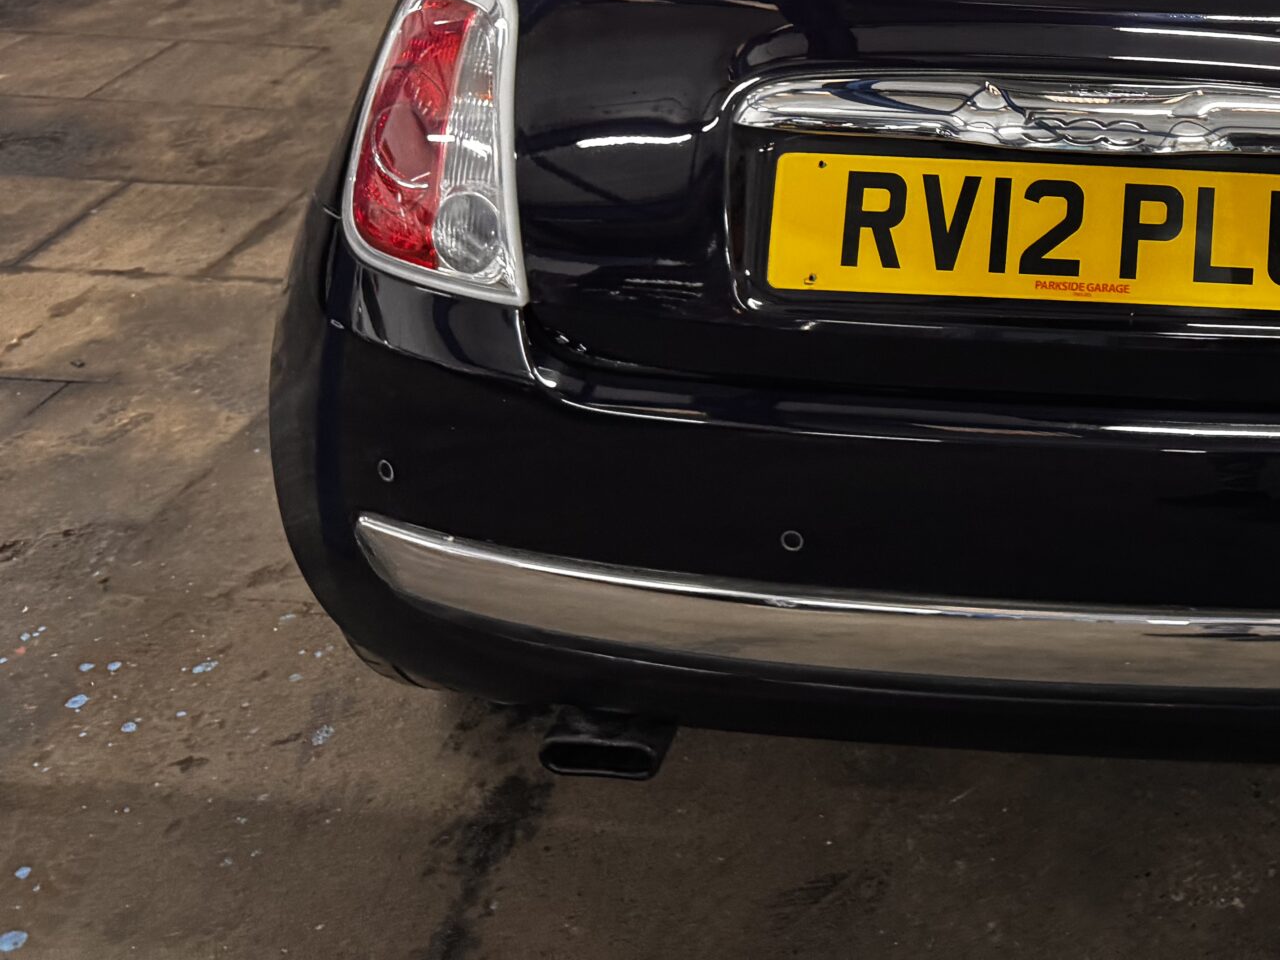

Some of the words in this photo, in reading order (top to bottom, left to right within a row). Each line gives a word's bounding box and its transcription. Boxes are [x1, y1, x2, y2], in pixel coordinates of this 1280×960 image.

[840, 170, 1085, 278] RV12
[1035, 280, 1086, 292] PARKSIDE
[1086, 282, 1130, 294] GARAGE
